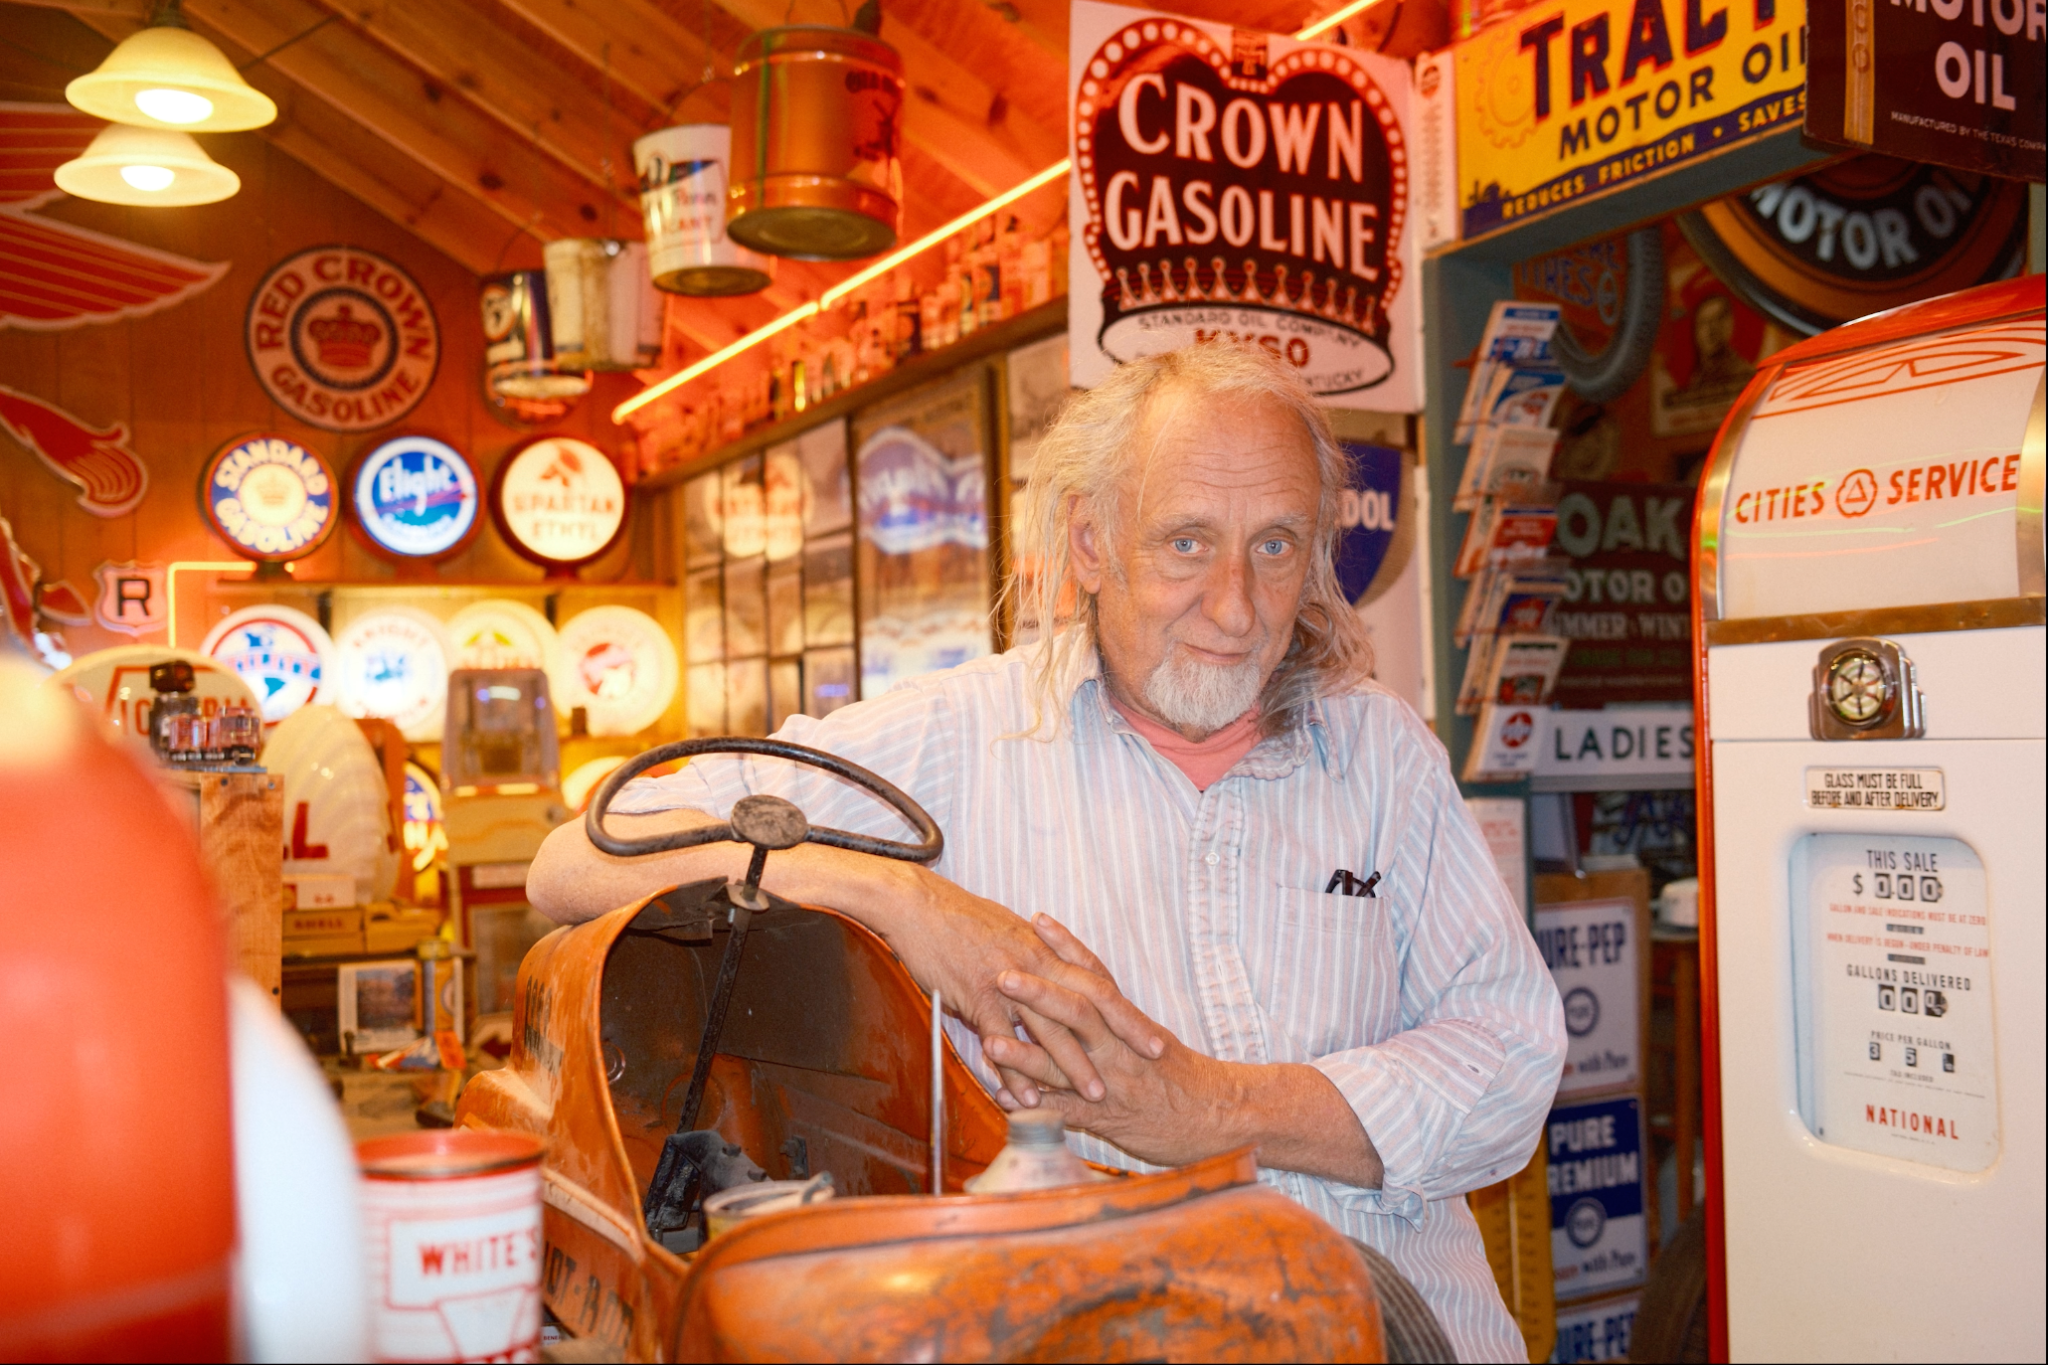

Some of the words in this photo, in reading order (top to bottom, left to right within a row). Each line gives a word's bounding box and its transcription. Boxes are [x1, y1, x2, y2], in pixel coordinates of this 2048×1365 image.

[1518, 0, 1776, 122] TRAC
[1935, 41, 2016, 112] OIL
[1118, 74, 1363, 183] CROWN
[1560, 66, 1714, 160] MOTOR
[1891, 111, 1958, 134] MANUFACTURED
[1959, 125, 1971, 137] BY
[1973, 128, 1989, 141] THE
[1990, 132, 2018, 148] TEXAS
[1502, 174, 1587, 220] REDUCES
[1599, 132, 1697, 185] FRICTION
[1104, 171, 1379, 282] GASOLINE
[256, 271, 305, 350] RED
[313, 255, 432, 361] CROWN
[1139, 311, 1232, 330] STANDARD
[1238, 312, 1266, 328] OIL
[271, 367, 420, 422] GASOLINE
[214, 438, 329, 496] STANDARD
[1735, 481, 1827, 524] CITIES
[1886, 454, 2021, 505] SERVICE
[1341, 489, 1395, 531] DOL
[1556, 492, 1686, 562] OAK
[117, 577, 150, 617] R
[1564, 568, 1655, 603] OTOR
[1555, 727, 1695, 761] LADIES
[1811, 790, 1842, 806] BEFORE
[1844, 790, 1862, 806] AND
[1865, 791, 1891, 807] AFTER
[1824, 773, 1854, 788] GLASS
[1857, 773, 1883, 789] MUST
[1886, 773, 1897, 789] BE
[1900, 773, 1922, 789] FULL
[1867, 850, 1896, 870] THIS
[1905, 851, 1938, 873] SALE
[1829, 903, 1852, 914] GALLON
[1854, 904, 1866, 916] AND
[1868, 905, 1883, 917] SALE
[1886, 907, 1926, 920] INDICATIONS
[1928, 910, 1945, 923] MUST
[1948, 912, 1957, 924] BE
[1959, 914, 1968, 924] AT
[1969, 914, 1986, 926] ZERO
[1537, 922, 1626, 970] URE-PEP
[1827, 932, 1843, 943] WHEN
[1845, 933, 1874, 947] DELIVERY
[1933, 943, 1962, 955] PENALTY
[1964, 945, 1973, 956] OF
[1974, 947, 1989, 958] LAW
[1847, 963, 1898, 982] GALLONS
[1903, 970, 1972, 991] DELIVERED
[1871, 1030, 1894, 1042] PRICE
[1898, 1034, 1913, 1046] PER
[1917, 1037, 1951, 1051] GALLON
[1551, 1115, 1616, 1155] PURE
[1866, 1104, 1959, 1140] NATIONAL
[1547, 1152, 1638, 1196] REMIUM
